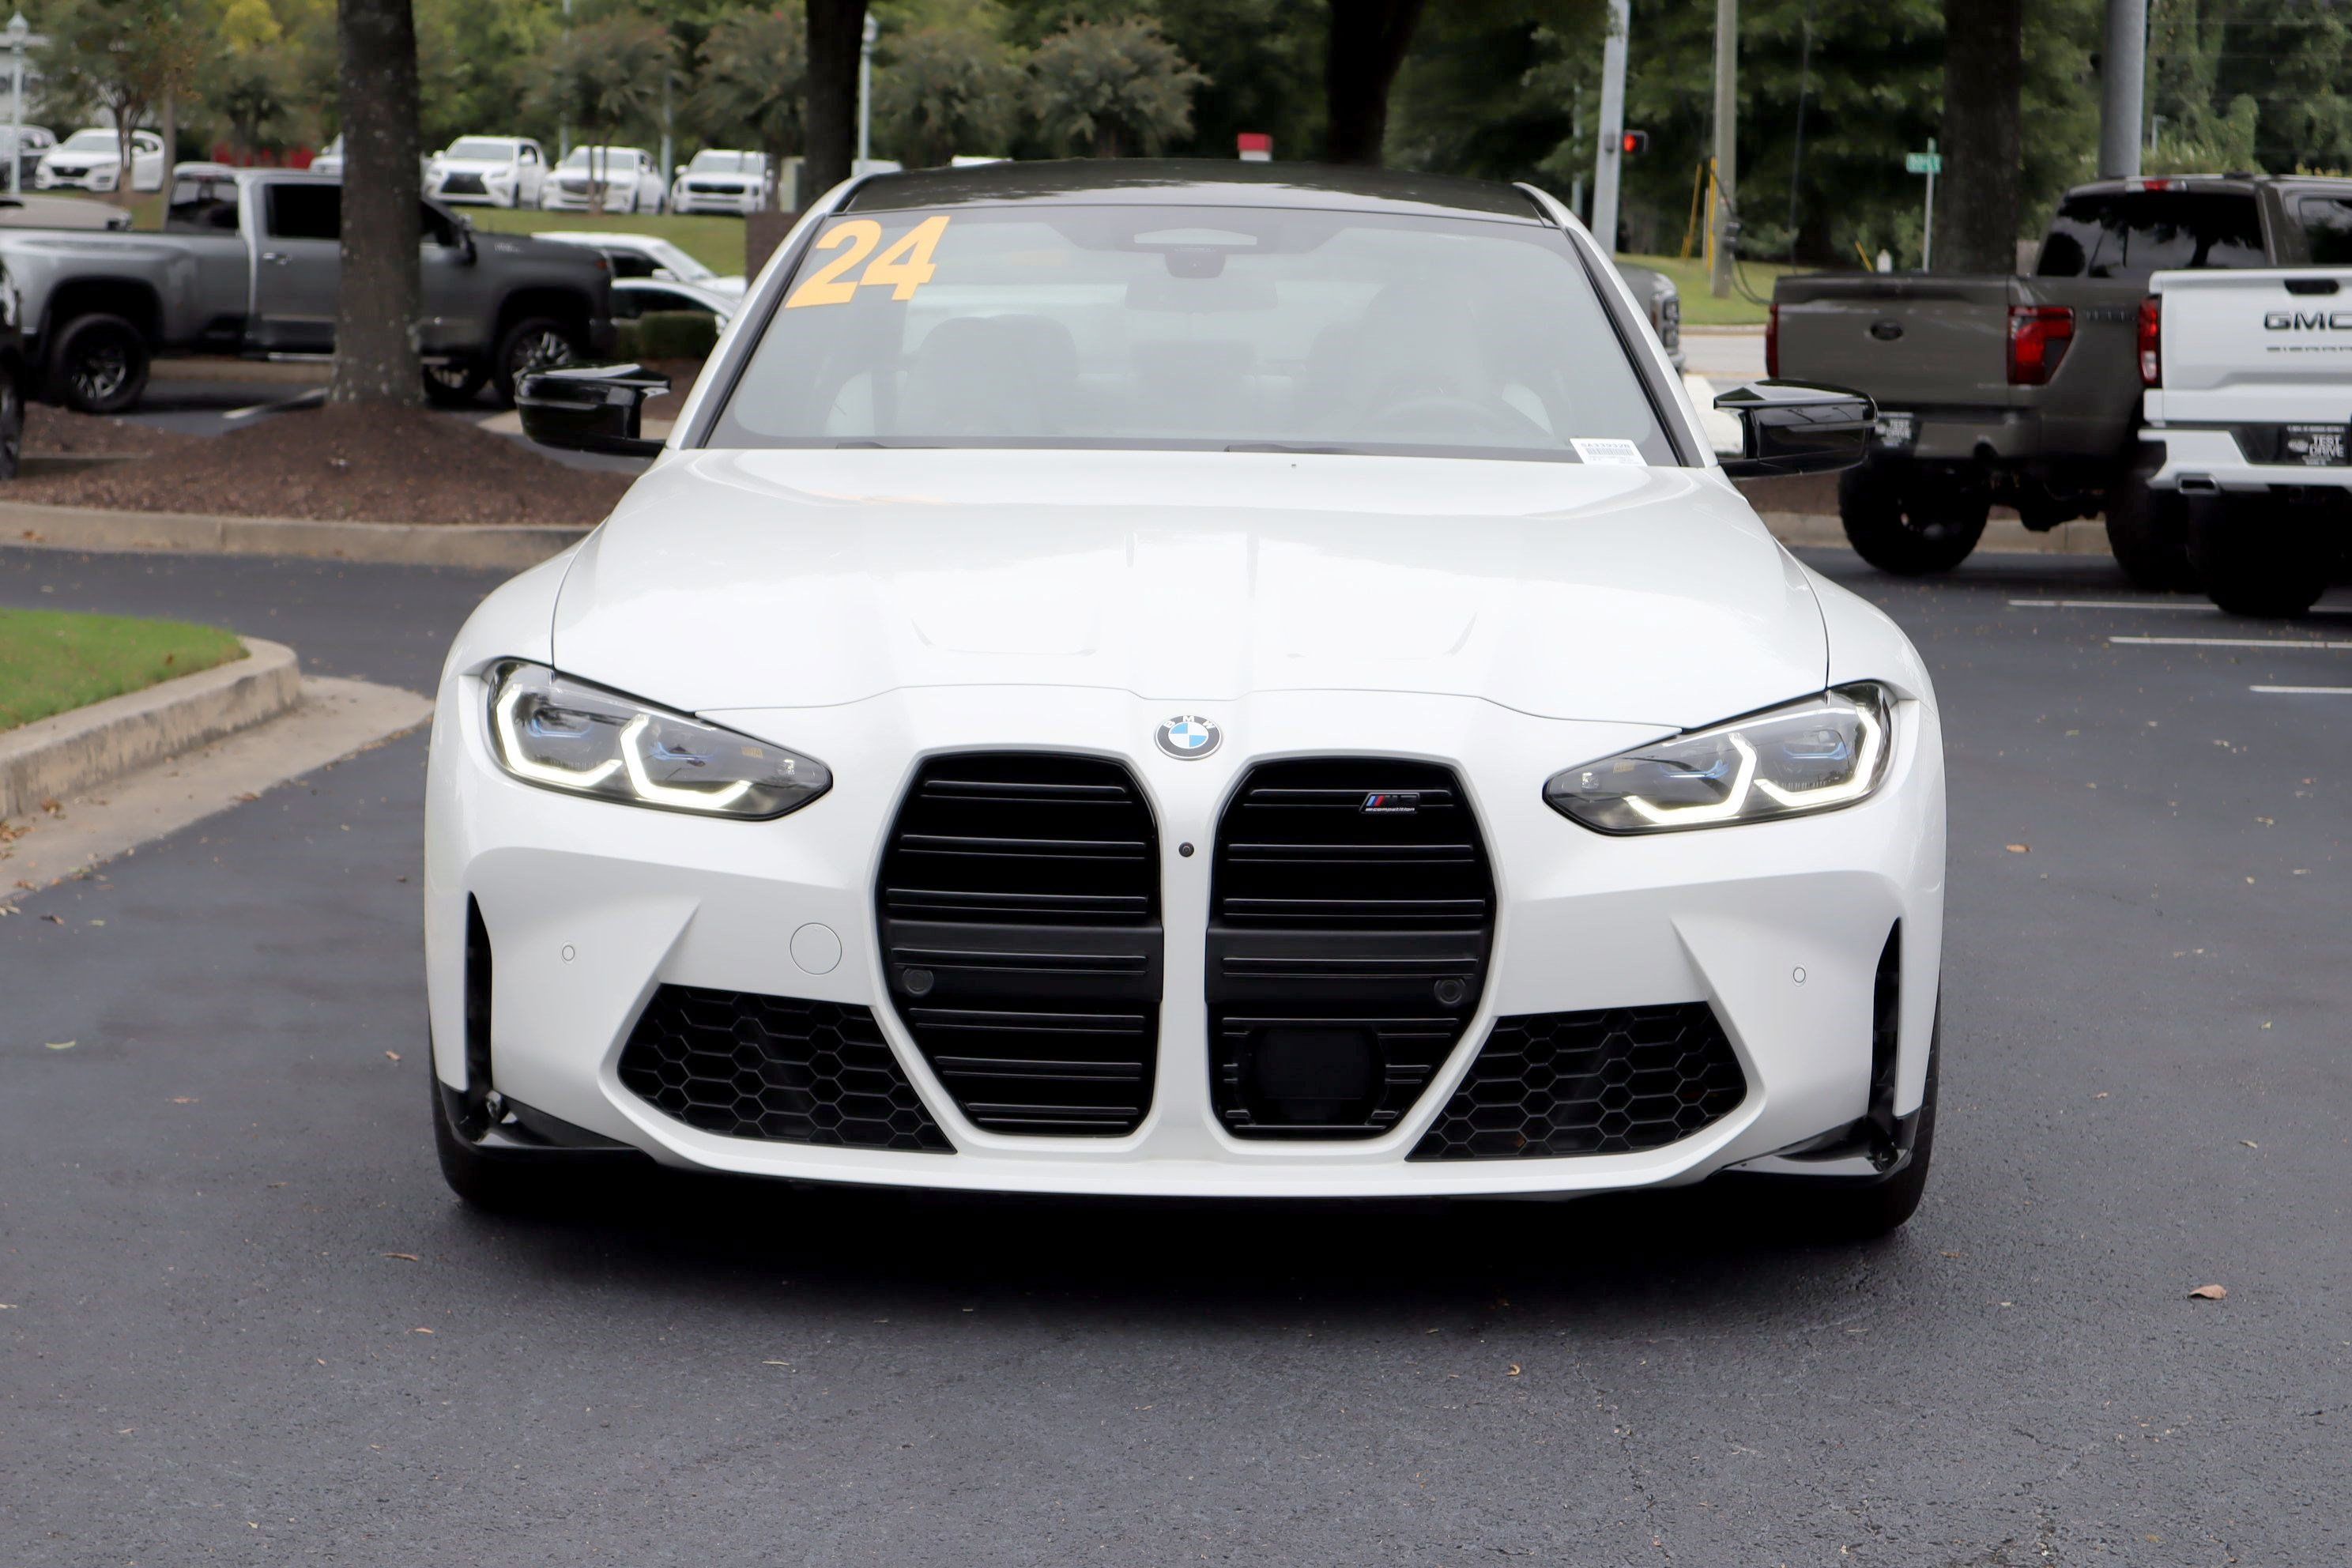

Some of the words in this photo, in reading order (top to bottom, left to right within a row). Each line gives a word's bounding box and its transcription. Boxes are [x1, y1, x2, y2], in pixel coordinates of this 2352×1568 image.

[785, 215, 951, 309] 24
[2263, 311, 2352, 330] GMC
[2312, 434, 2342, 445] TEST
[2309, 443, 2344, 457] DRIVE
[1163, 714, 1216, 729] BMW
